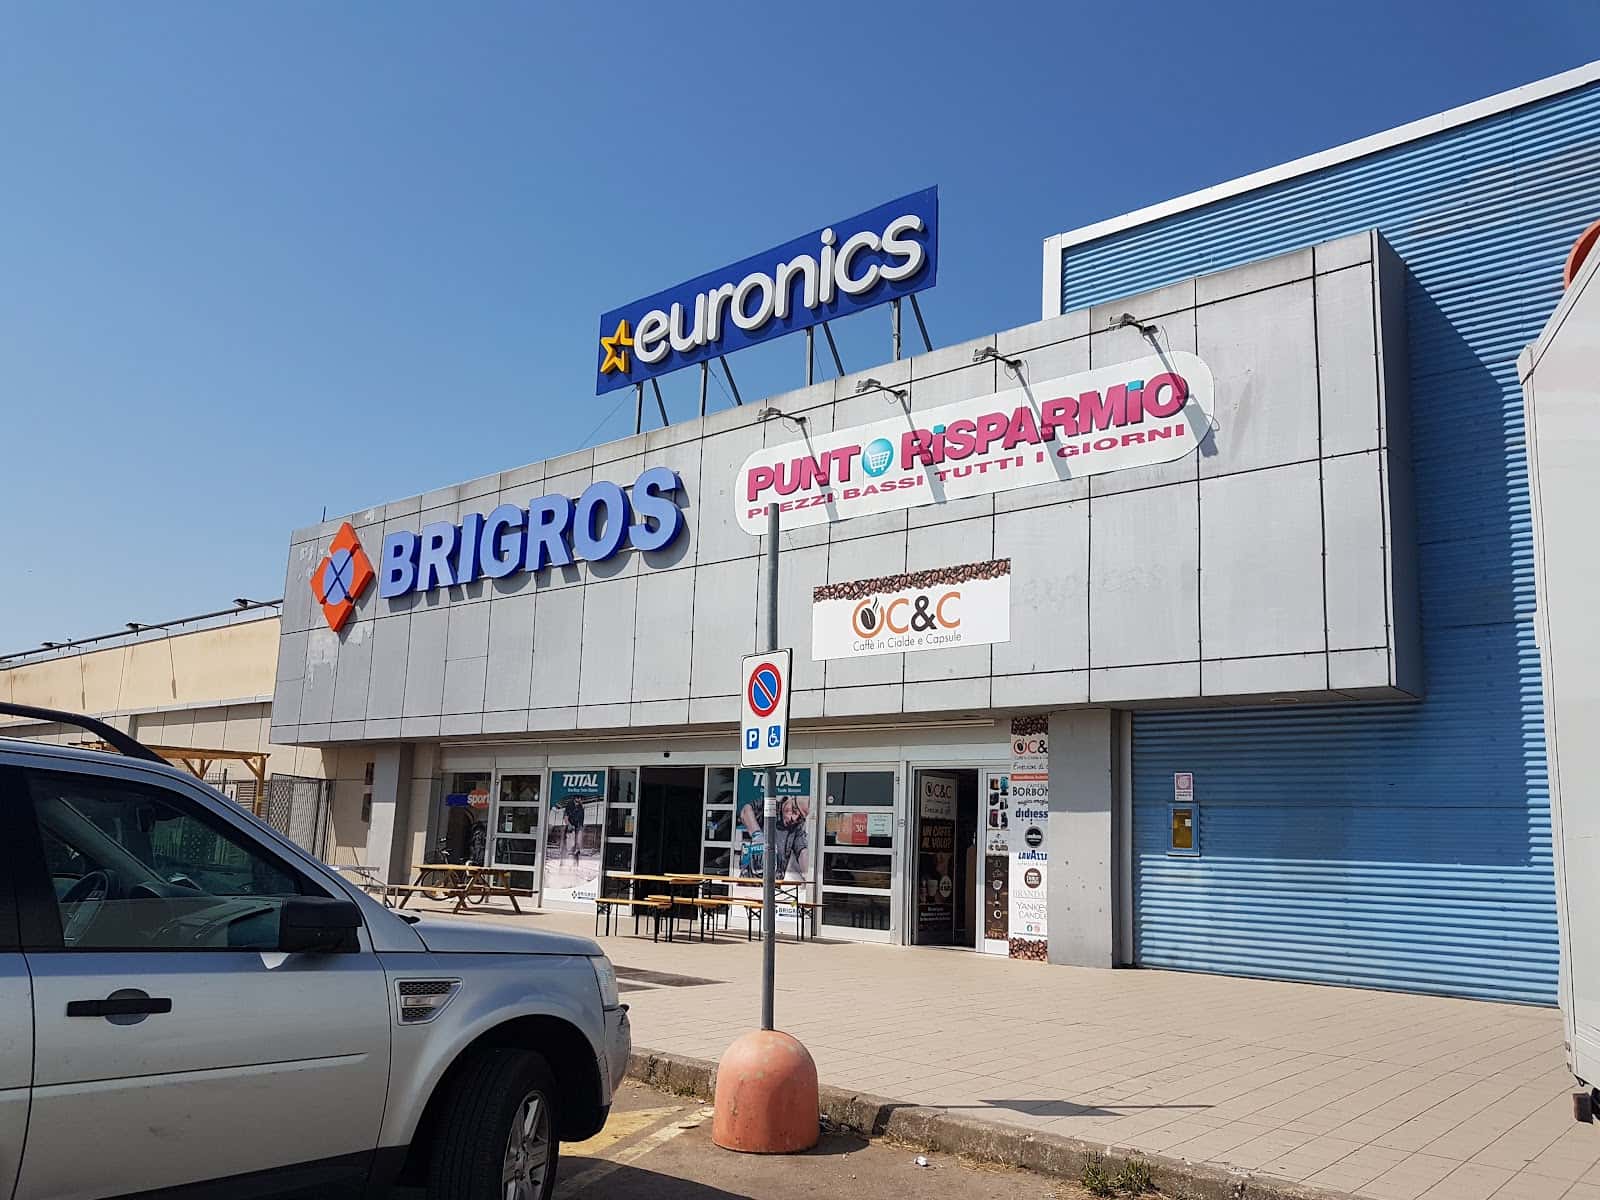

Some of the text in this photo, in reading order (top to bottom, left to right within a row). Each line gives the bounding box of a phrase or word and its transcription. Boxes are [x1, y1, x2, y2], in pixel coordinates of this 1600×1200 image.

[634, 215, 925, 363] euronics
[843, 475, 924, 500] BASSI
[935, 456, 1024, 481] TUTTI
[1036, 451, 1044, 463] I
[1056, 424, 1185, 458] GIORNI
[380, 466, 683, 599] BRIGROS
[853, 631, 962, 652] Caffè in Cialde e Capsule
[748, 730, 758, 748] P
[563, 774, 599, 787] TOTAL
